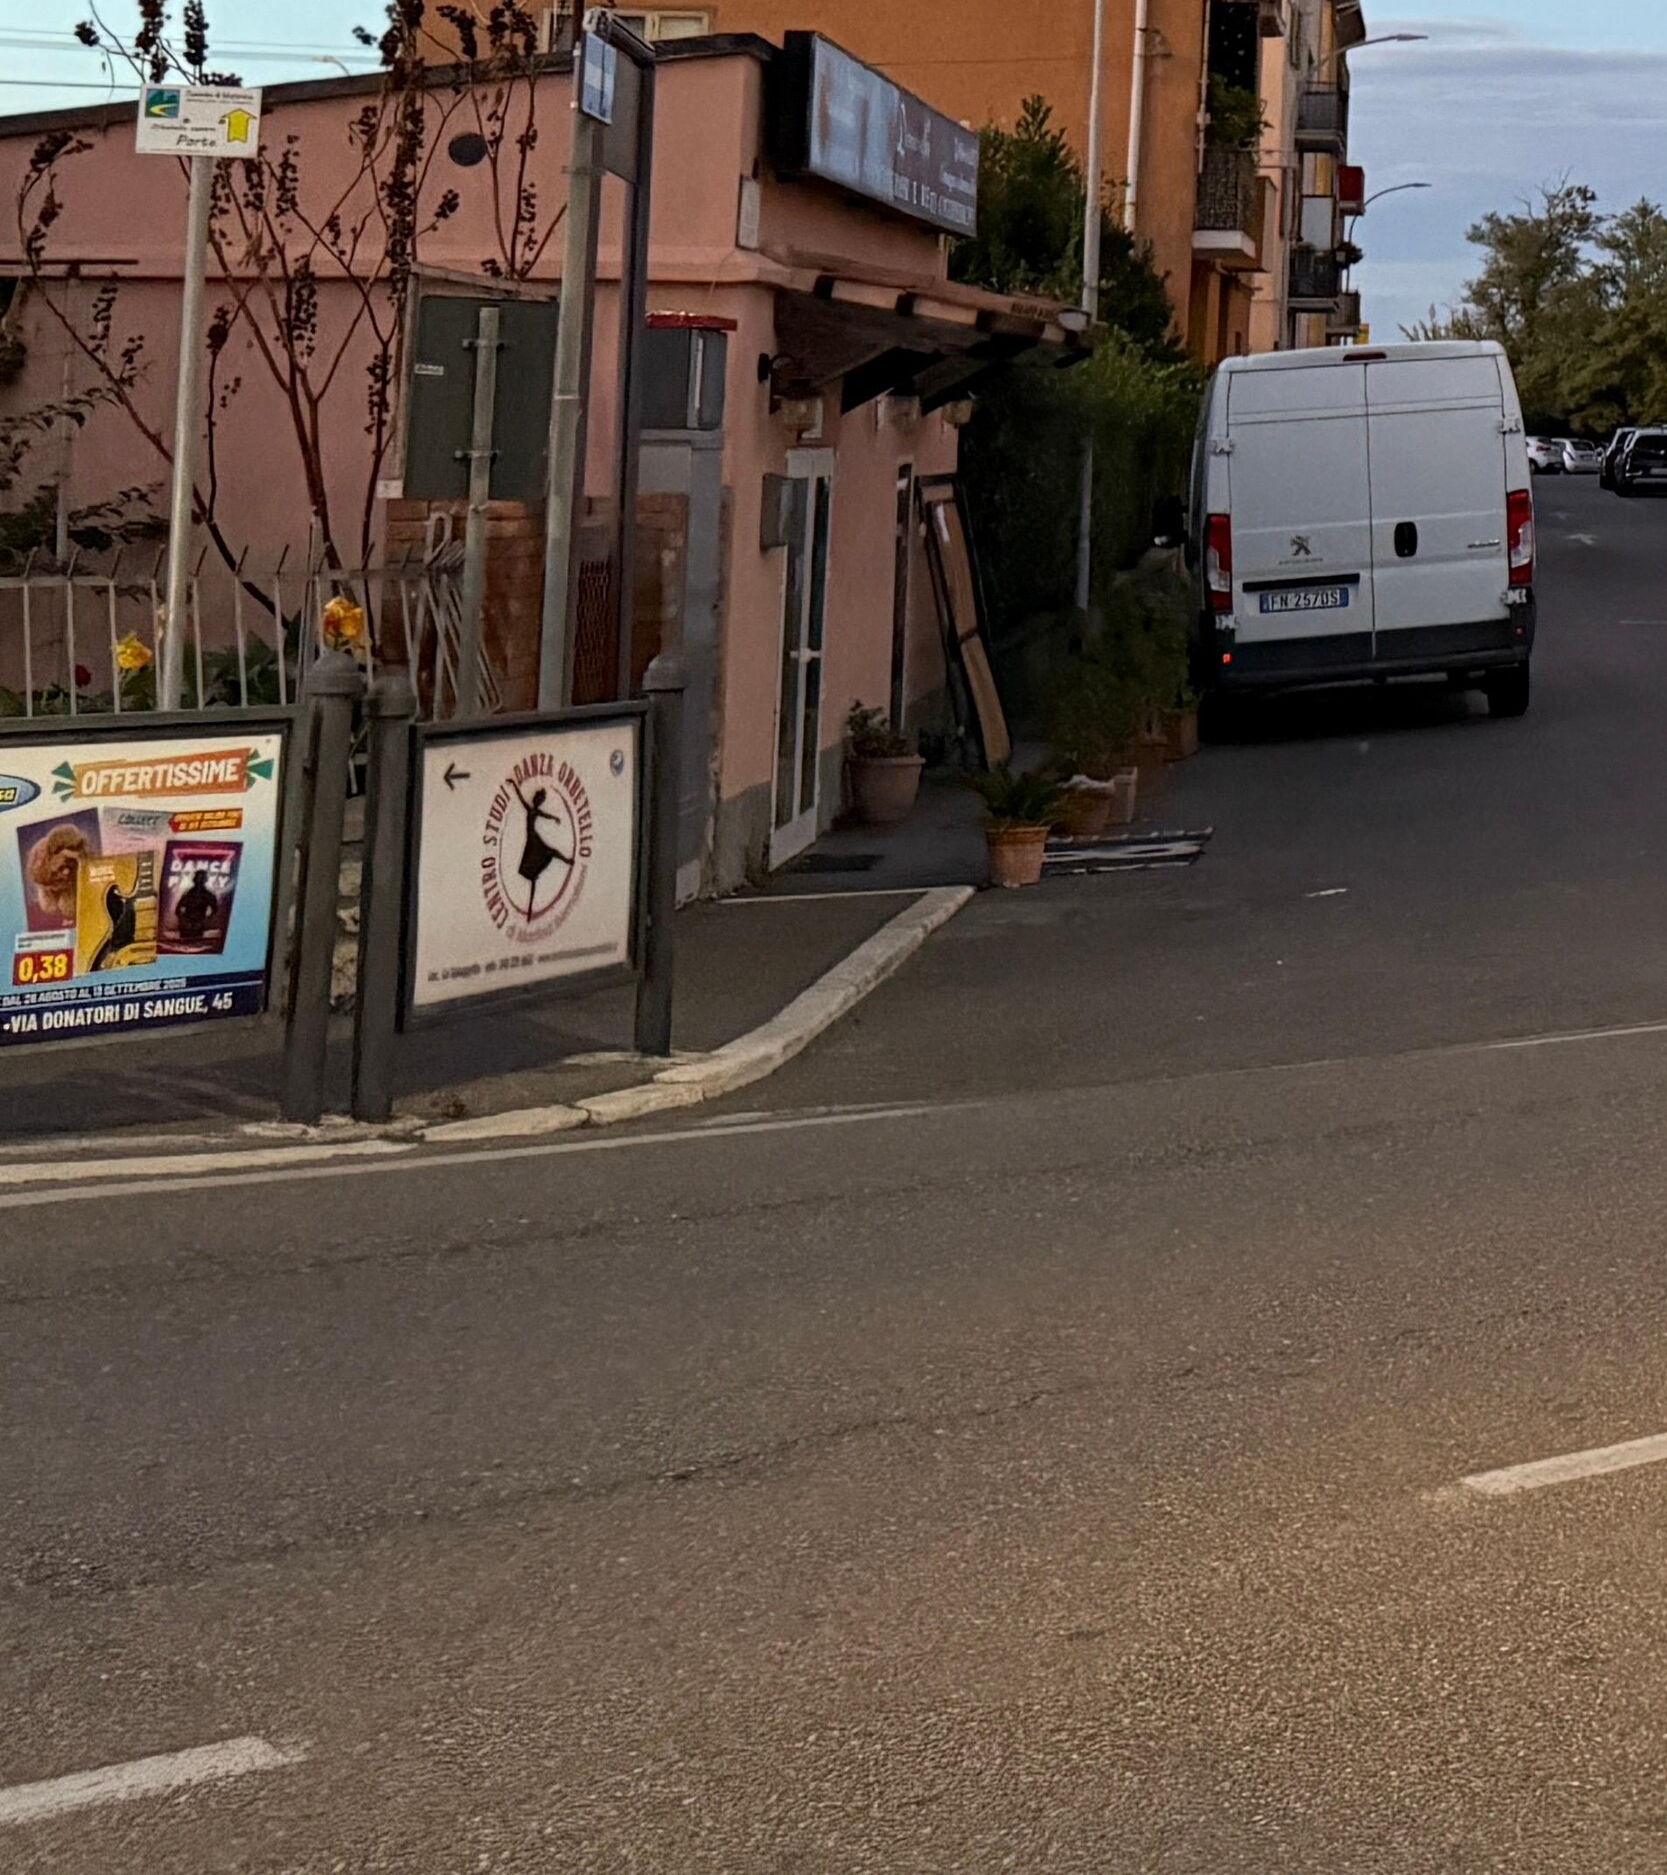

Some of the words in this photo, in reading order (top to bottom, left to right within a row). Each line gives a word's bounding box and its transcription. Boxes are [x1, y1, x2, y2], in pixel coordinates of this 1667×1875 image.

[81, 757, 241, 796] OFFERTISSIME
[481, 856, 509, 929] CENTRO
[513, 753, 554, 787] DANZA
[557, 760, 594, 859] ORBETELLO
[171, 859, 231, 873] DANCE
[18, 953, 68, 983] 0,38
[38, 988, 78, 1002] AGOSTO
[42, 1004, 120, 1030] DONATORI
[123, 1003, 140, 1021] DI
[143, 994, 209, 1018] SANGUE,
[212, 991, 234, 1010] 45
